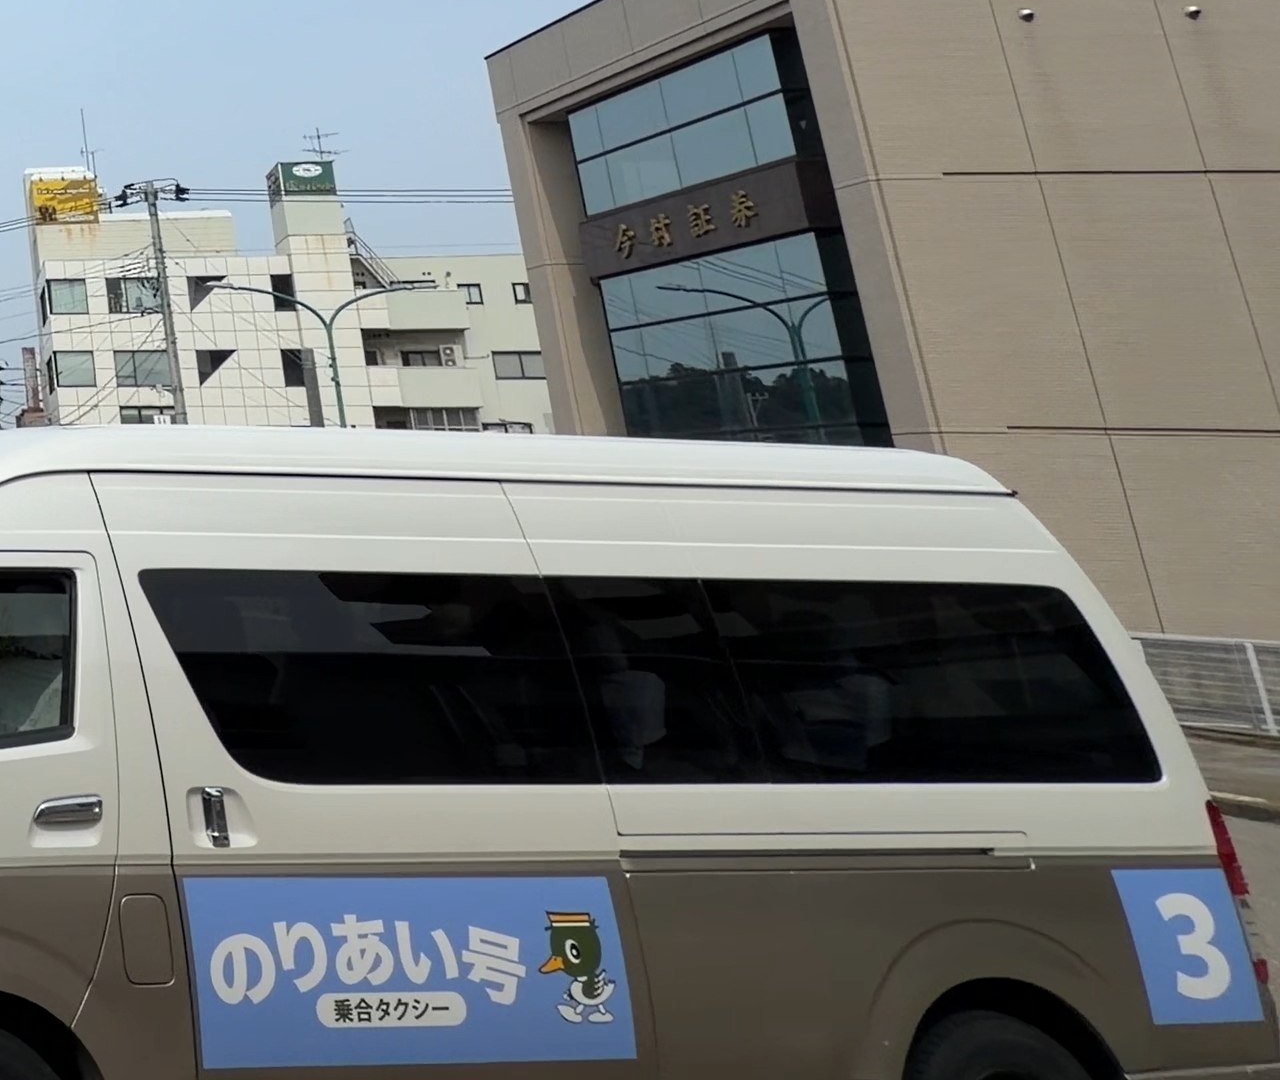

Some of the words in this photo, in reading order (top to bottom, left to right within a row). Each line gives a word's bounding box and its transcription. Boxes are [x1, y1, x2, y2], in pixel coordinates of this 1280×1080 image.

[614, 189, 757, 260] 今村証券
[210, 914, 527, 1006] のりあい号
[1155, 892, 1232, 1000] 3
[333, 997, 450, 1024] 乗合タクシー
